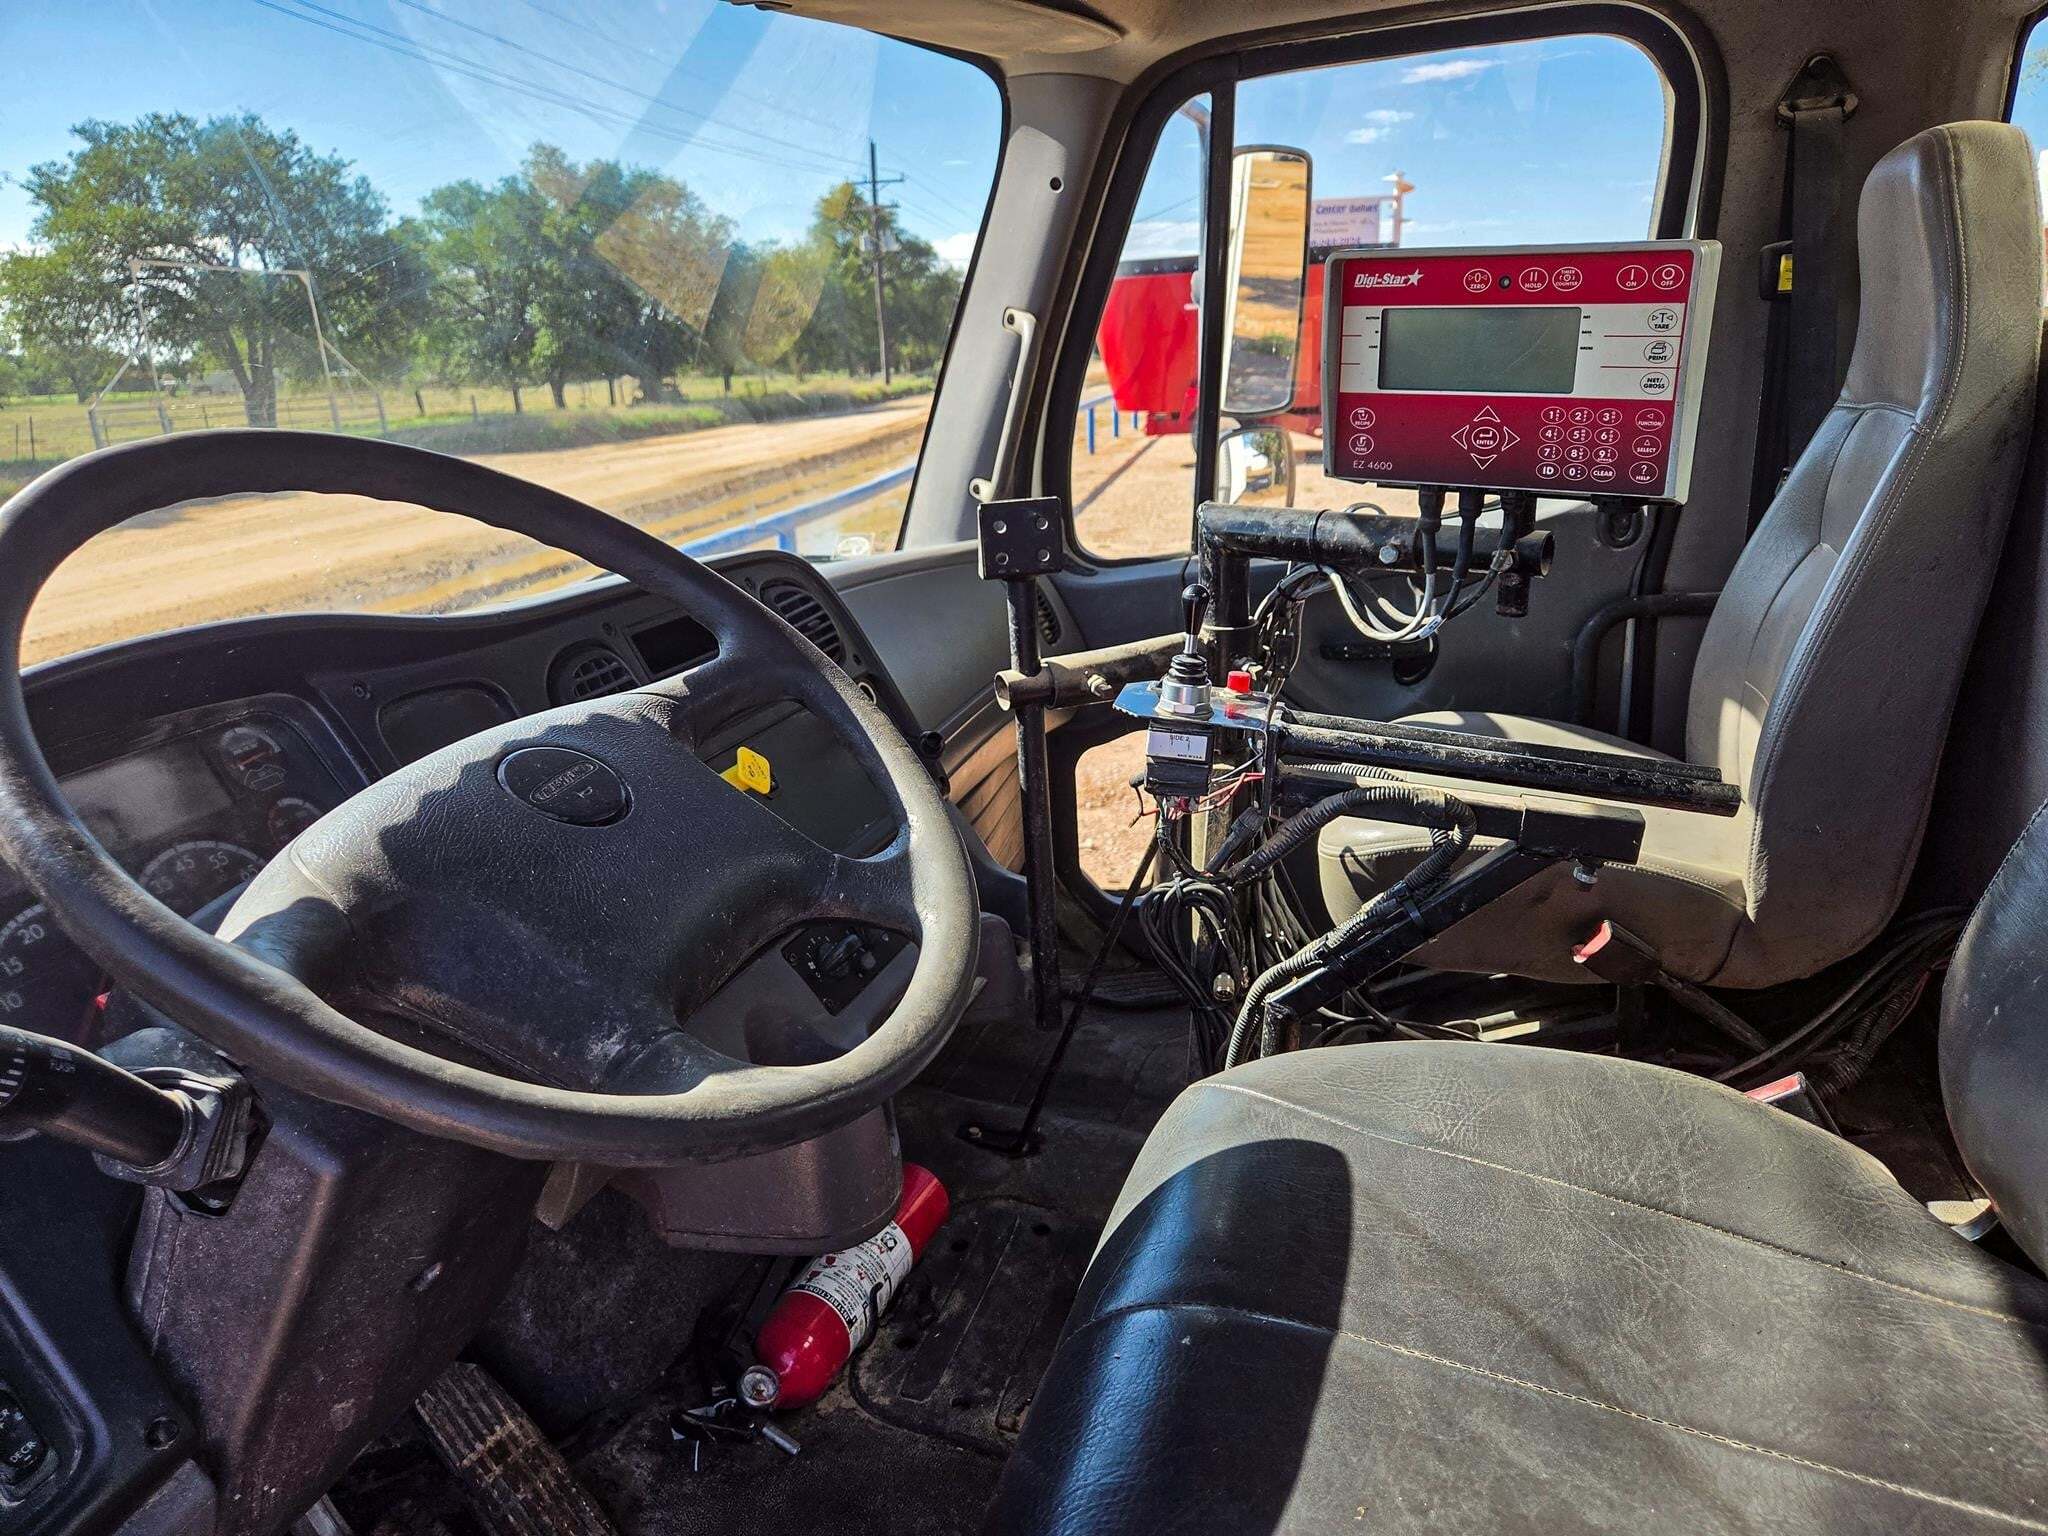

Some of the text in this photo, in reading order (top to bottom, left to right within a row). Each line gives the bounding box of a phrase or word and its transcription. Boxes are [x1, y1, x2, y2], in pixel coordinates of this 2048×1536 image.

[1354, 273, 1408, 288] Digi-Star
[1353, 460, 1393, 470] EZ 4600
[1542, 466, 1555, 475] ID
[208, 850, 230, 870] 55
[17, 923, 45, 945] 20
[9, 1441, 37, 1463] DECR
